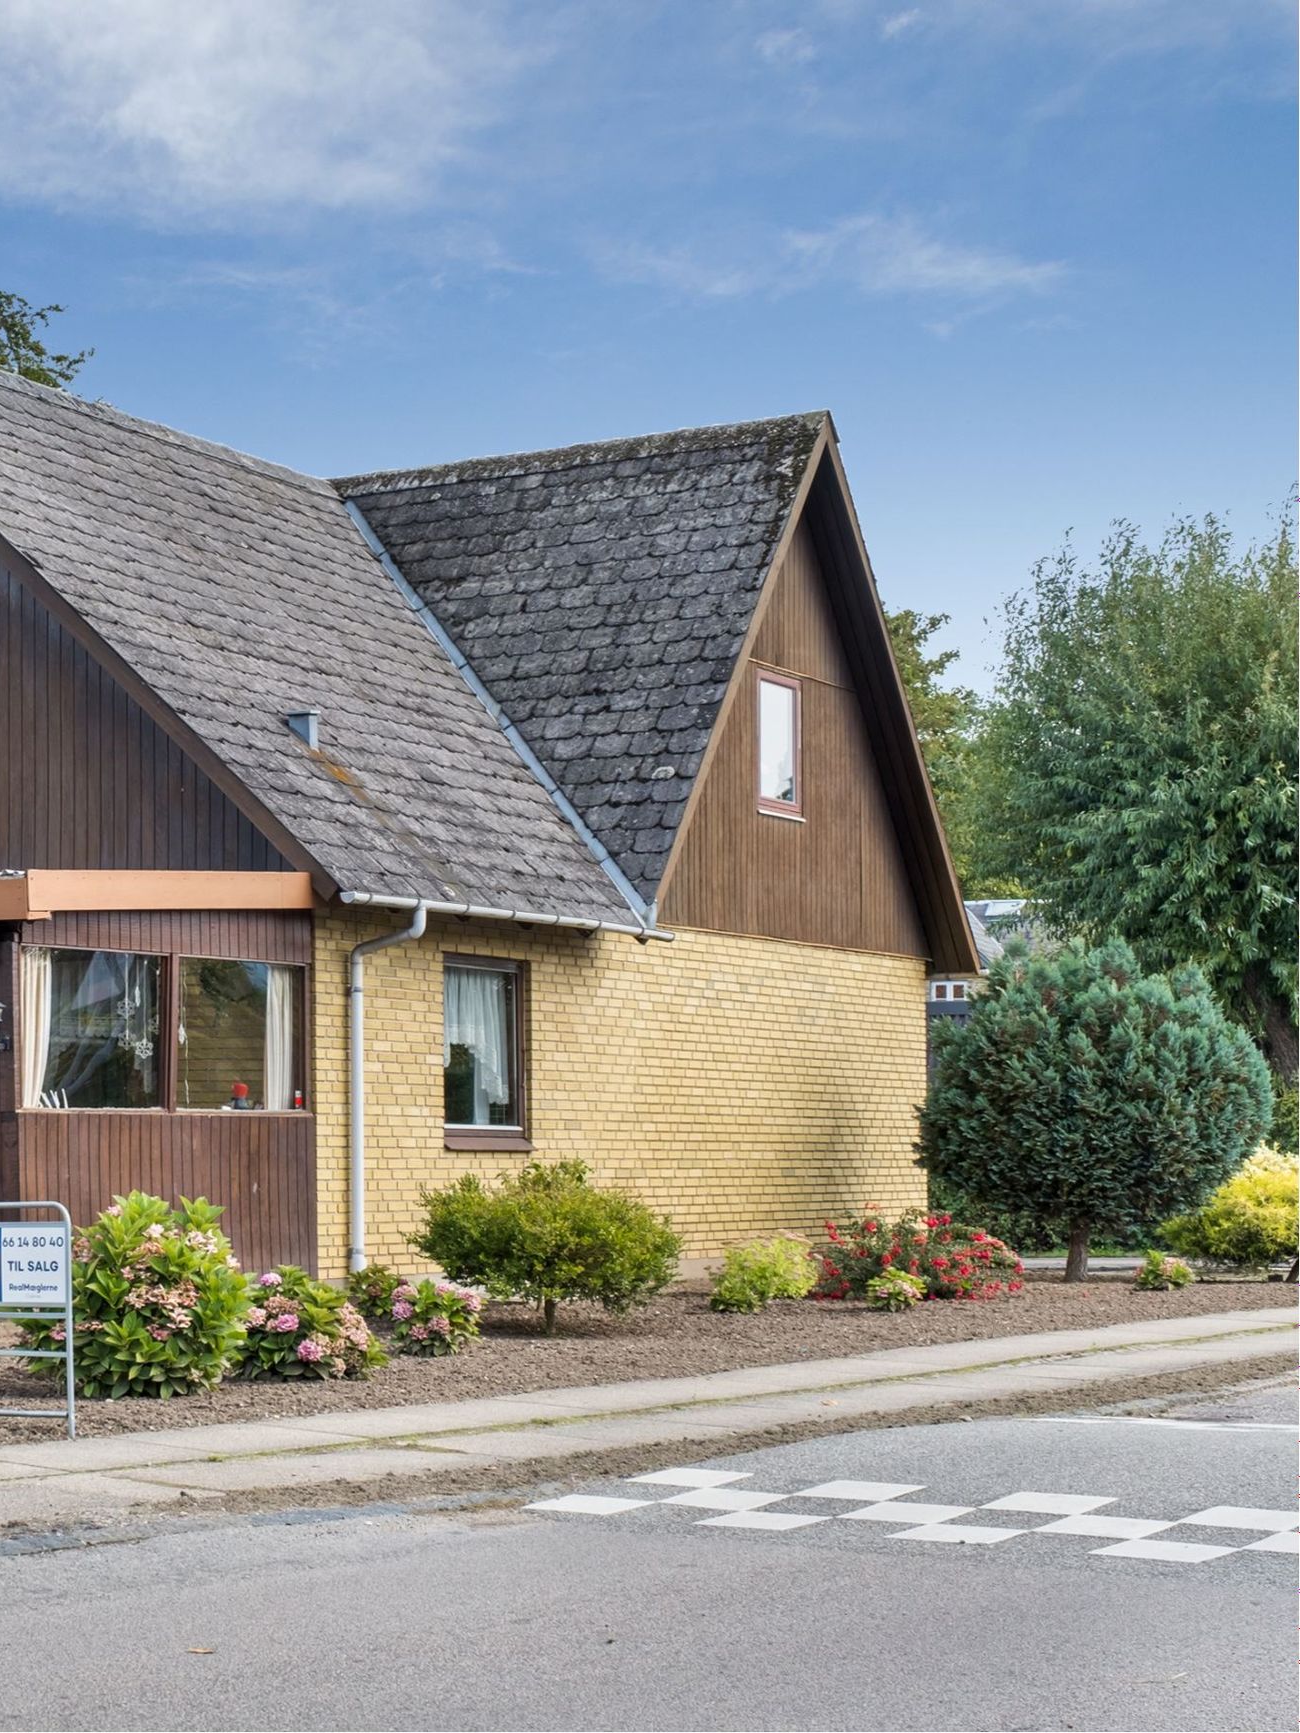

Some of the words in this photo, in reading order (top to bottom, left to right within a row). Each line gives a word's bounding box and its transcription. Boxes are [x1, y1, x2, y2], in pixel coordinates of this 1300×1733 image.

[2, 1236, 15, 1248] 66
[17, 1236, 30, 1248] 14
[31, 1236, 47, 1248] 80
[49, 1236, 64, 1248] 40
[7, 1260, 25, 1272] TIL
[27, 1260, 59, 1272] SALG
[8, 1282, 59, 1294] RealMæglerne
